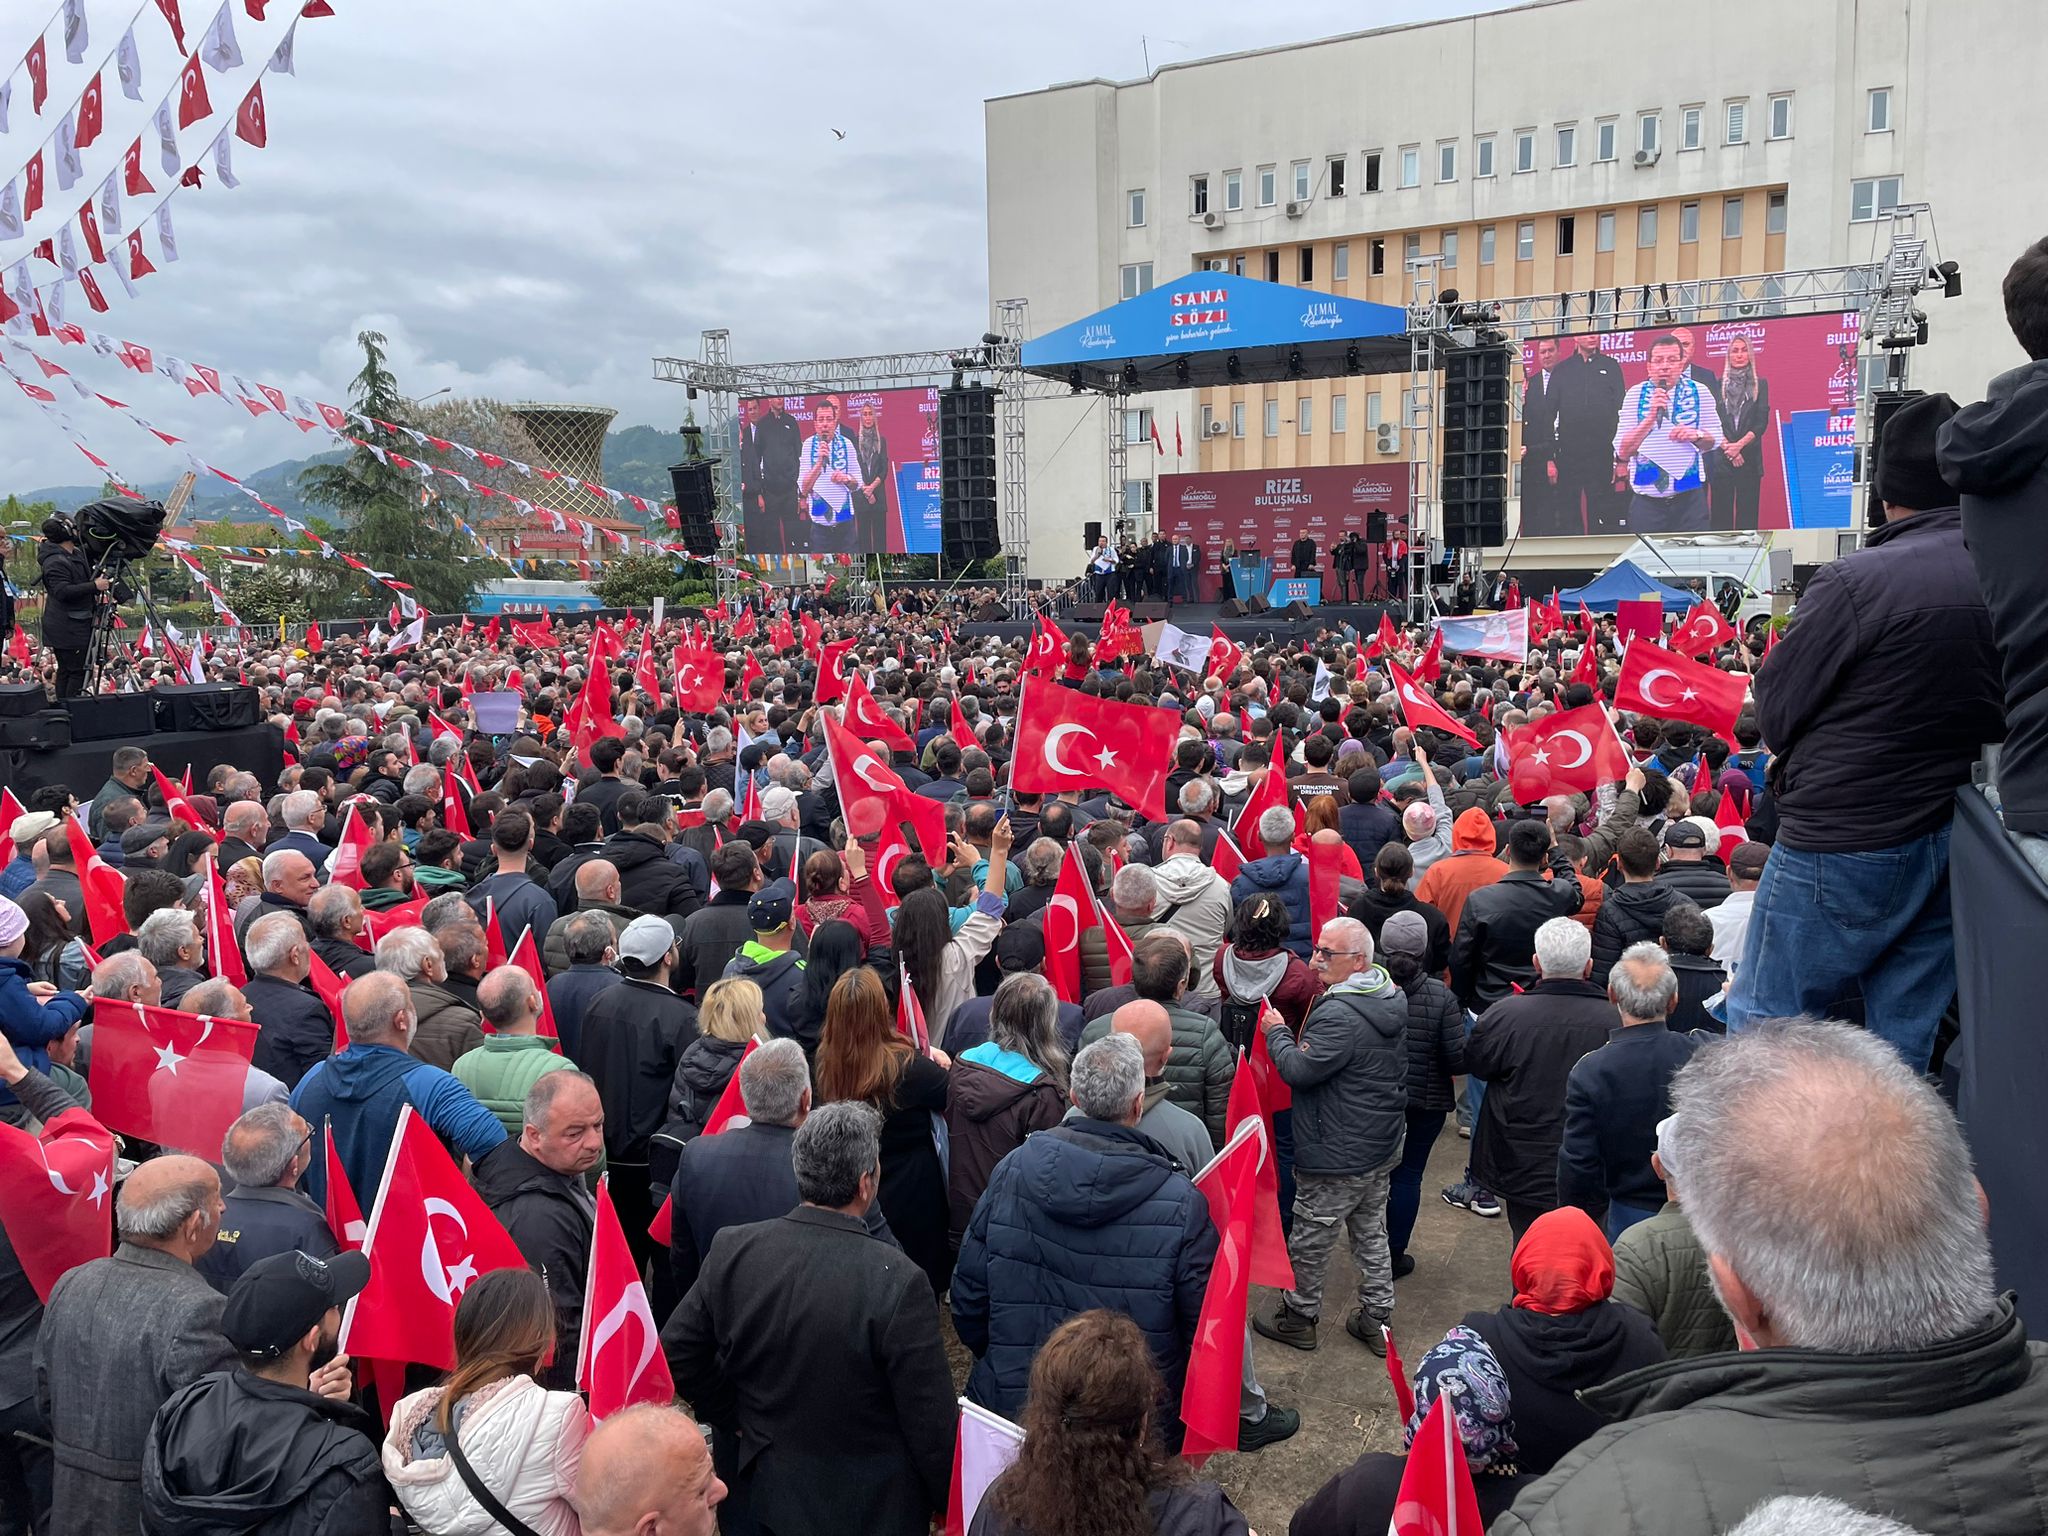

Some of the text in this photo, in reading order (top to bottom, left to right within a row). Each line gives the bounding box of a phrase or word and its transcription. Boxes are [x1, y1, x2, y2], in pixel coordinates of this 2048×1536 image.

[1174, 288, 1225, 306] SANA
[1174, 308, 1225, 326] SÖZ!
[1254, 494, 1312, 507] BULUŞMASI
[503, 602, 543, 615] SANA
